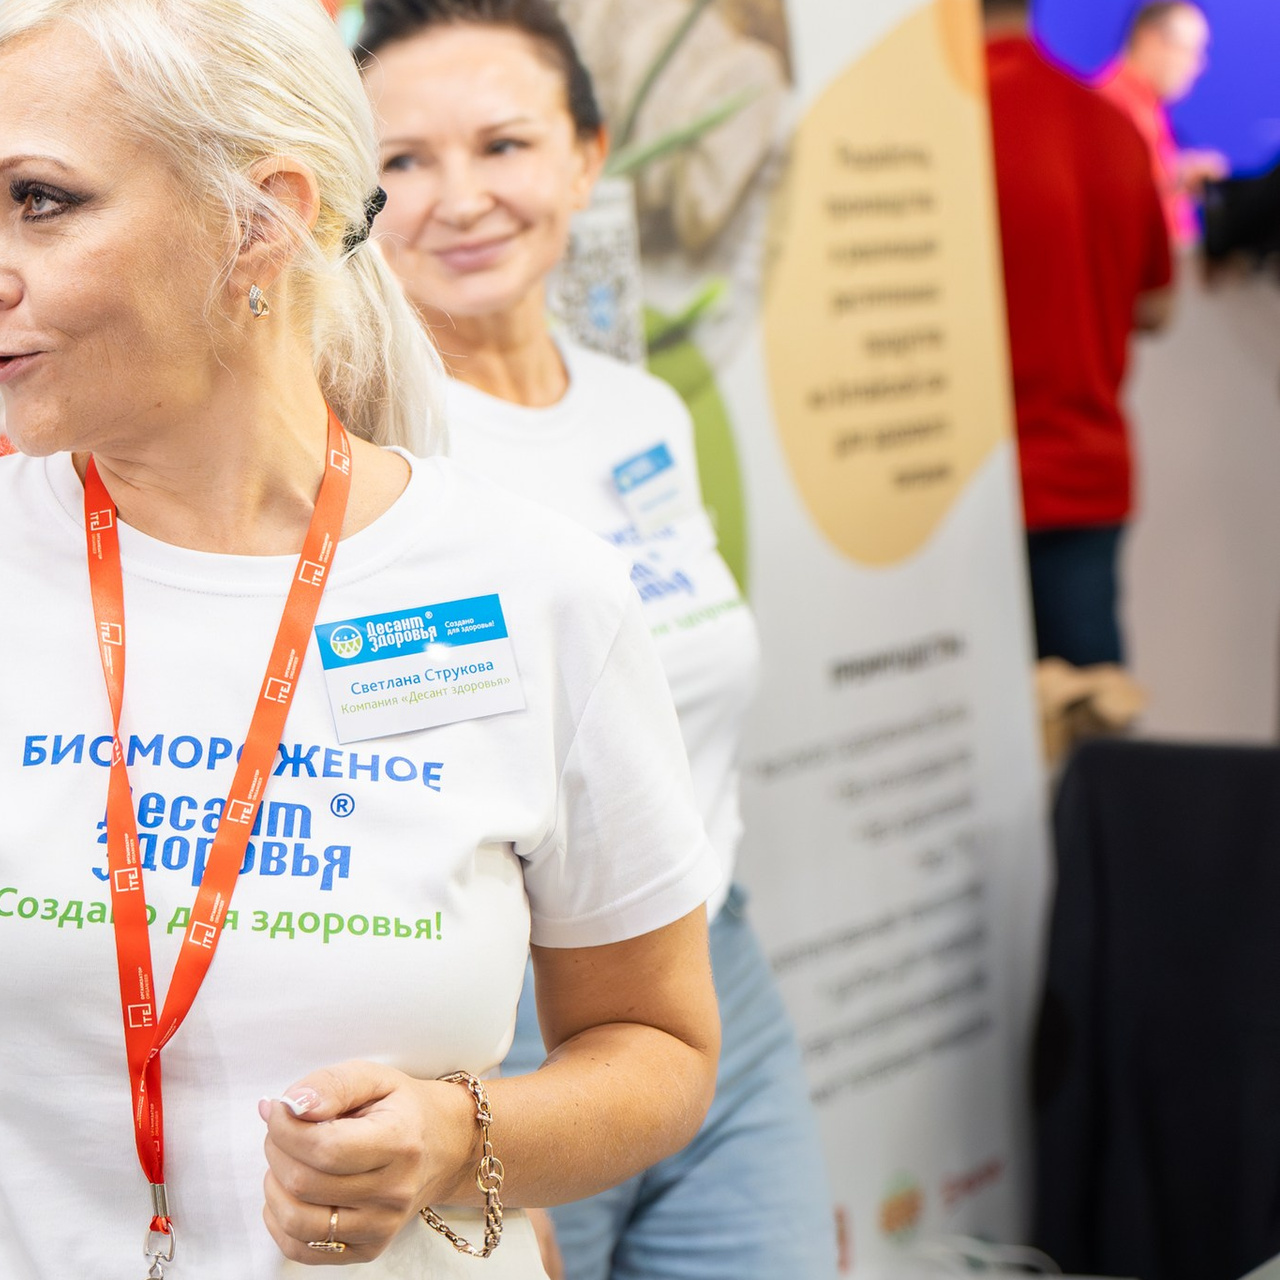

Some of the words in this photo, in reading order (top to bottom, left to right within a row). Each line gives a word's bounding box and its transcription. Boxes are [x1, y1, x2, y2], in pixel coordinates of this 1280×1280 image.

[310, 568, 324, 587] ITE
[366, 616, 425, 639] Десант
[444, 617, 475, 629] Создано
[447, 626, 461, 637] для
[461, 619, 496, 634] здоровья!
[350, 671, 421, 696] Светлана
[423, 660, 495, 683] Струкова
[276, 684, 292, 704] ITE
[340, 696, 399, 715] Компания
[401, 685, 449, 705] «Десант
[451, 675, 512, 697] здоровья»
[22, 733, 445, 793] БИОМОРЖЕНОЕ
[239, 806, 254, 825] ITE
[129, 872, 140, 891] ITE
[166, 906, 239, 935] дя
[250, 909, 443, 944] здоровья!
[201, 929, 216, 950] ITE
[142, 1008, 153, 1028] ITE
